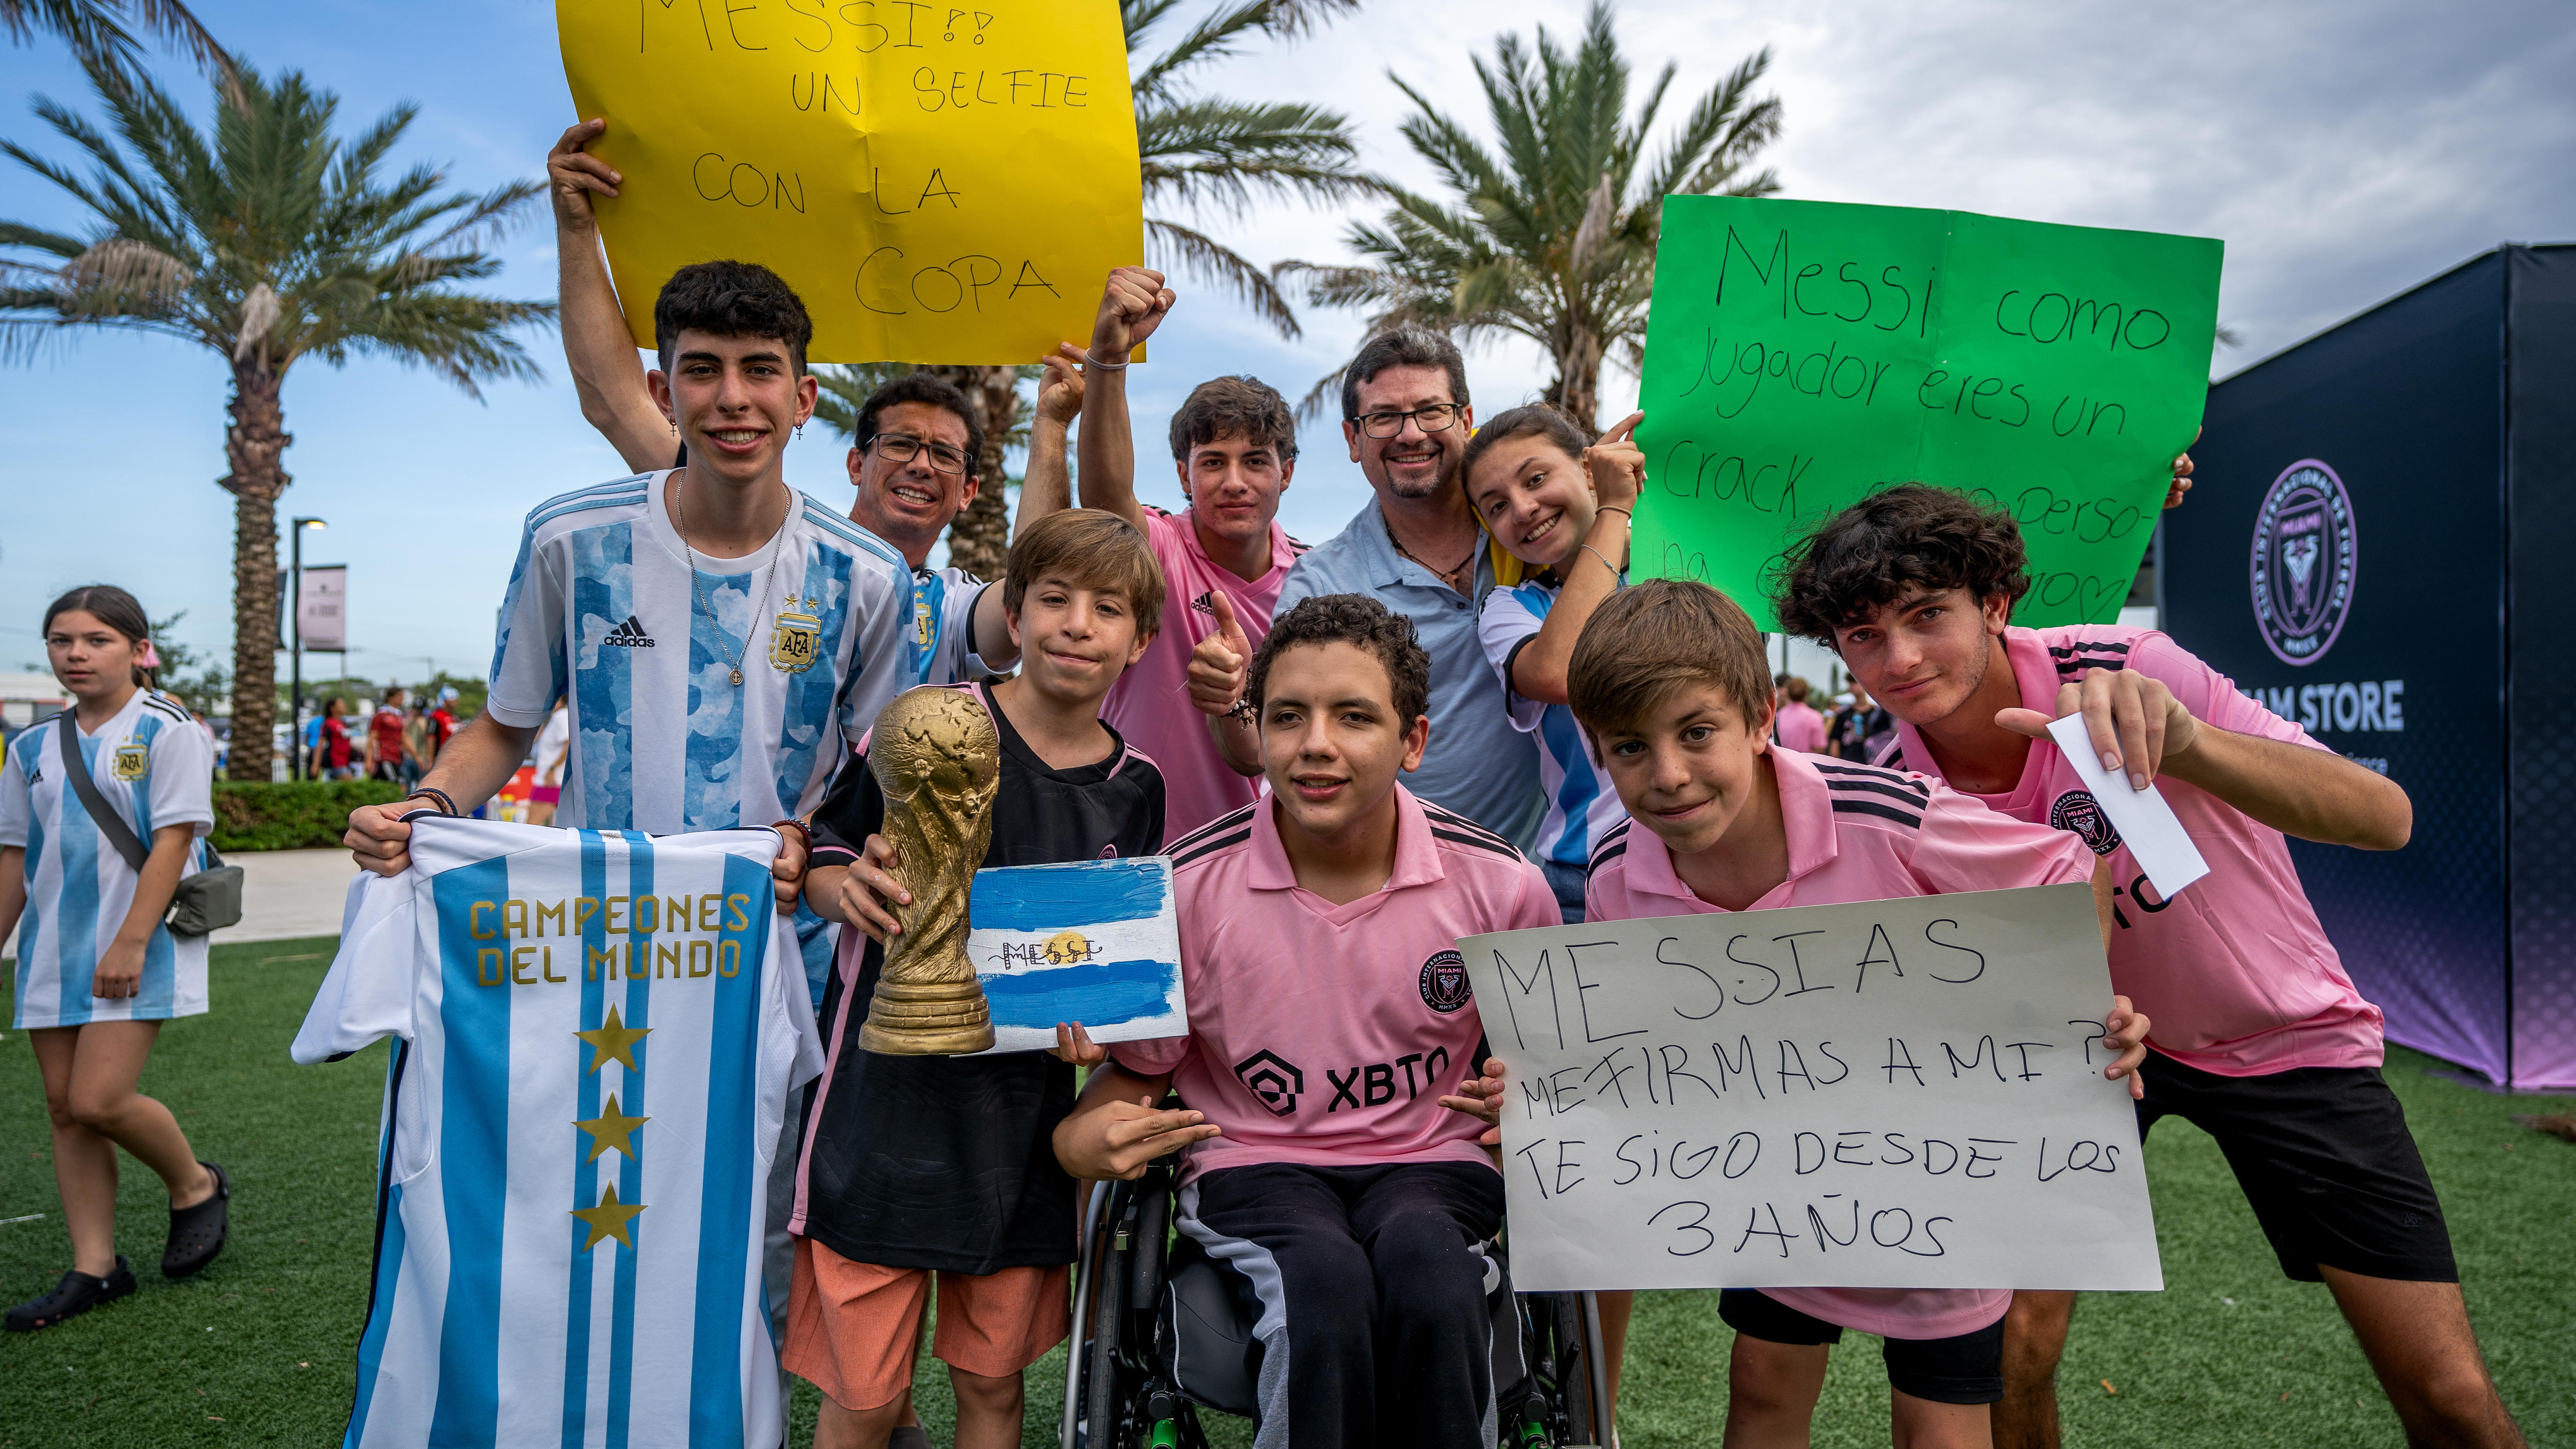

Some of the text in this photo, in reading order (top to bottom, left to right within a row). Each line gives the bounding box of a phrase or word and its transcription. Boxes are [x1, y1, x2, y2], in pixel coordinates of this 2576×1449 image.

[792, 67, 1087, 115] UN SELFIE
[693, 153, 960, 214] CON LA
[856, 247, 1060, 314] COPA
[1716, 225, 2170, 351] Messi como
[1919, 370, 2029, 427] eres
[2053, 396, 2125, 436] un
[1191, 602, 1215, 617] adida
[603, 634, 656, 648] adidas
[781, 628, 809, 658] AFA
[2239, 679, 2404, 733] AM STORE
[2066, 807, 2094, 818] MIAMI
[2094, 844, 2111, 853] MXX
[470, 893, 750, 940] CAMPEONES
[477, 939, 741, 986] DEL MUNDO
[1002, 940, 1094, 970] MESSI
[1493, 919, 1985, 1050] MESSIAS
[1516, 1138, 1585, 1199] TE
[1794, 1132, 2018, 1178] DESDE
[2038, 1137, 2120, 1182] LOS
[1734, 1194, 1953, 1258] AÑOS
